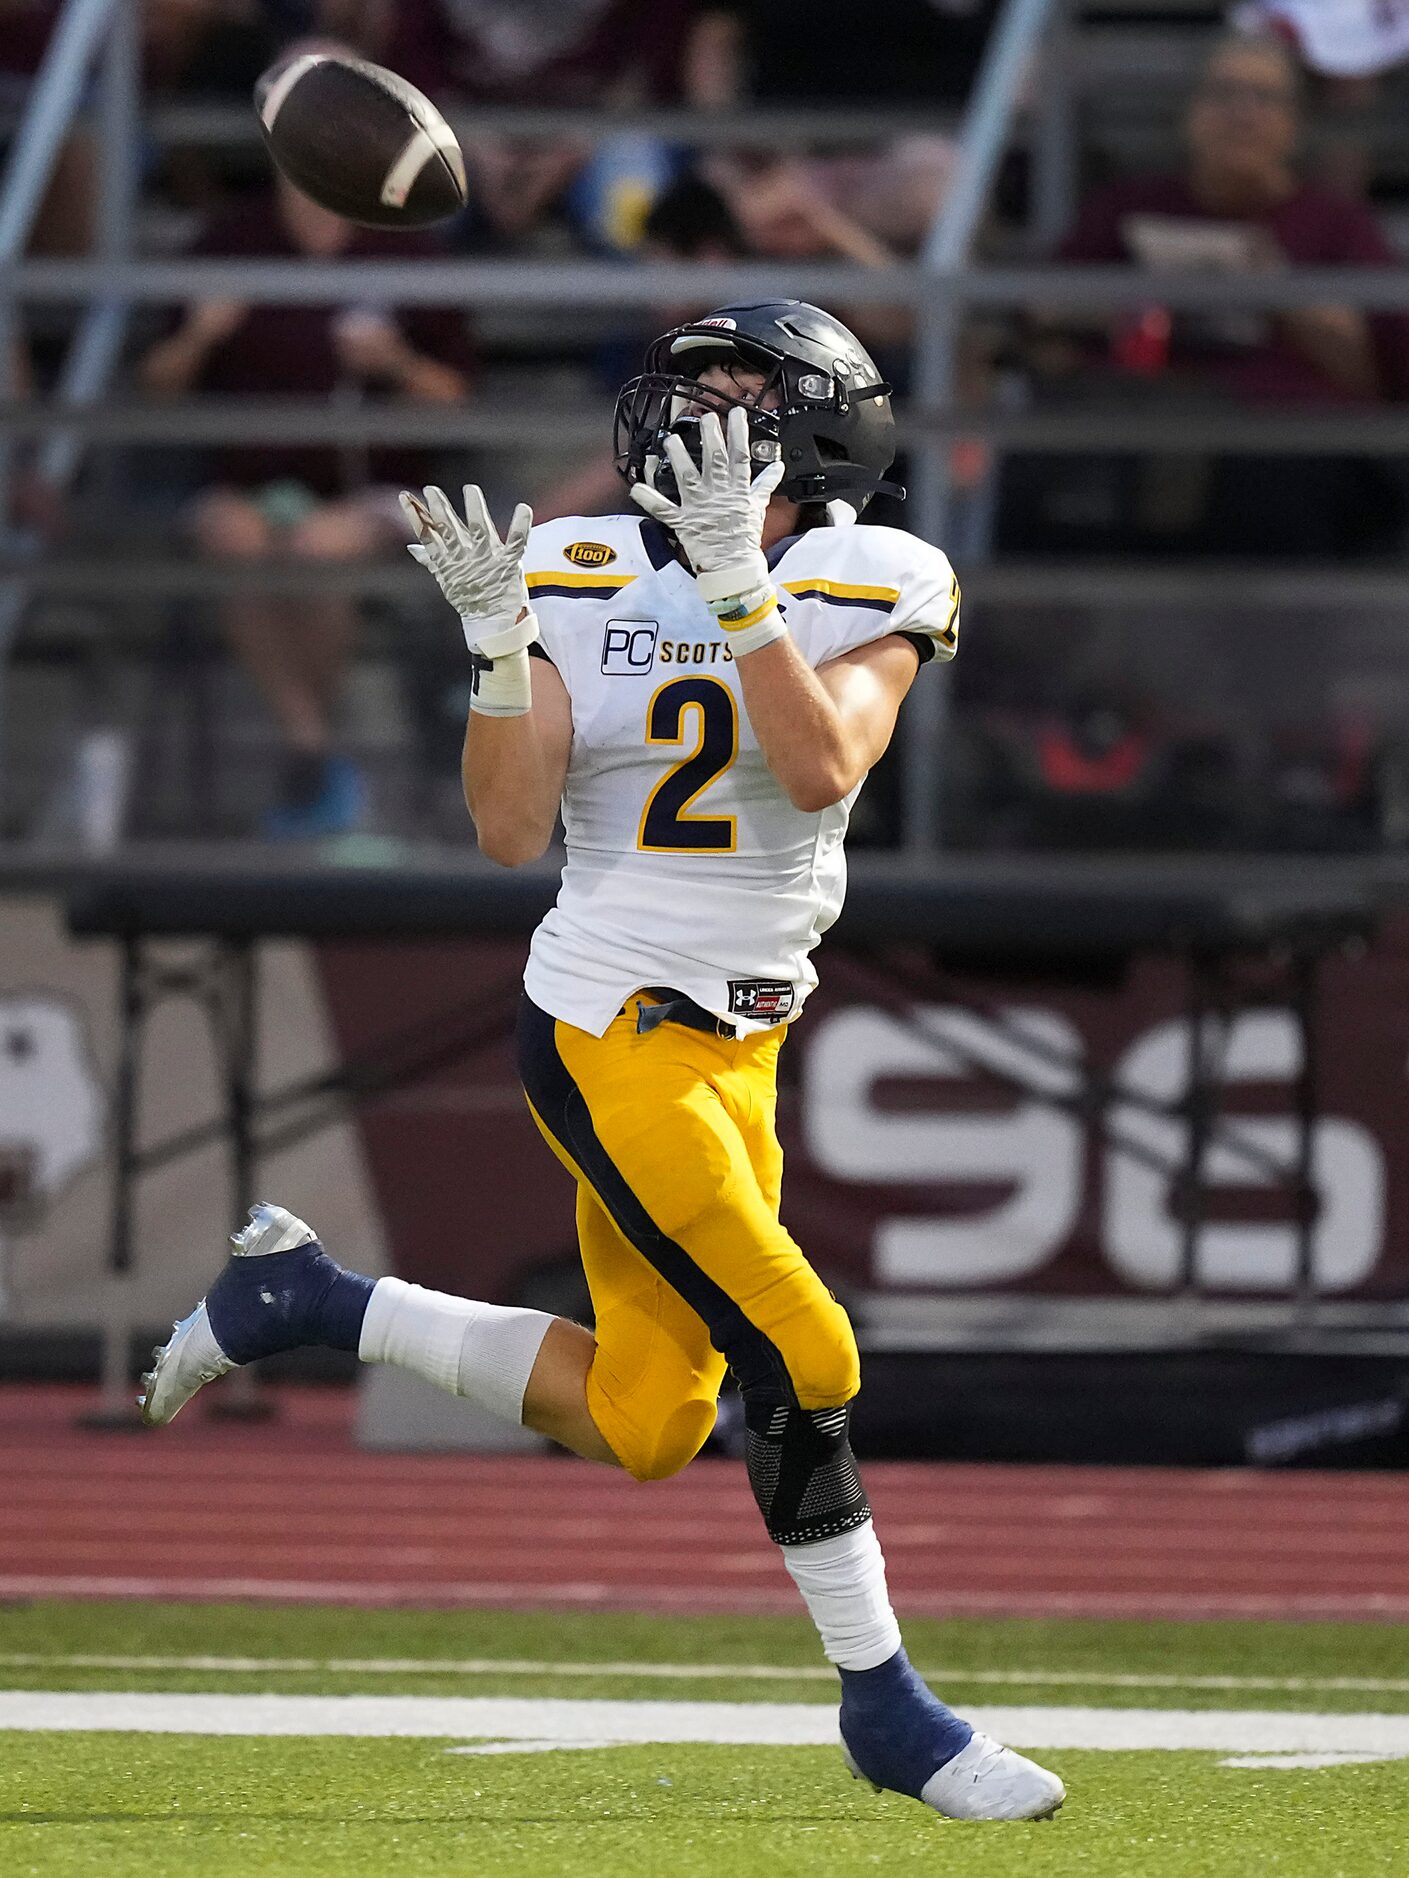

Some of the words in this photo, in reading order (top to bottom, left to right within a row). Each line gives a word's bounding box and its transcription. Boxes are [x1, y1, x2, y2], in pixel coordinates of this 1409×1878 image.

[575, 548, 603, 562] 100
[603, 628, 655, 666] PC
[659, 641, 734, 664] SCOTS
[637, 673, 740, 853] 2
